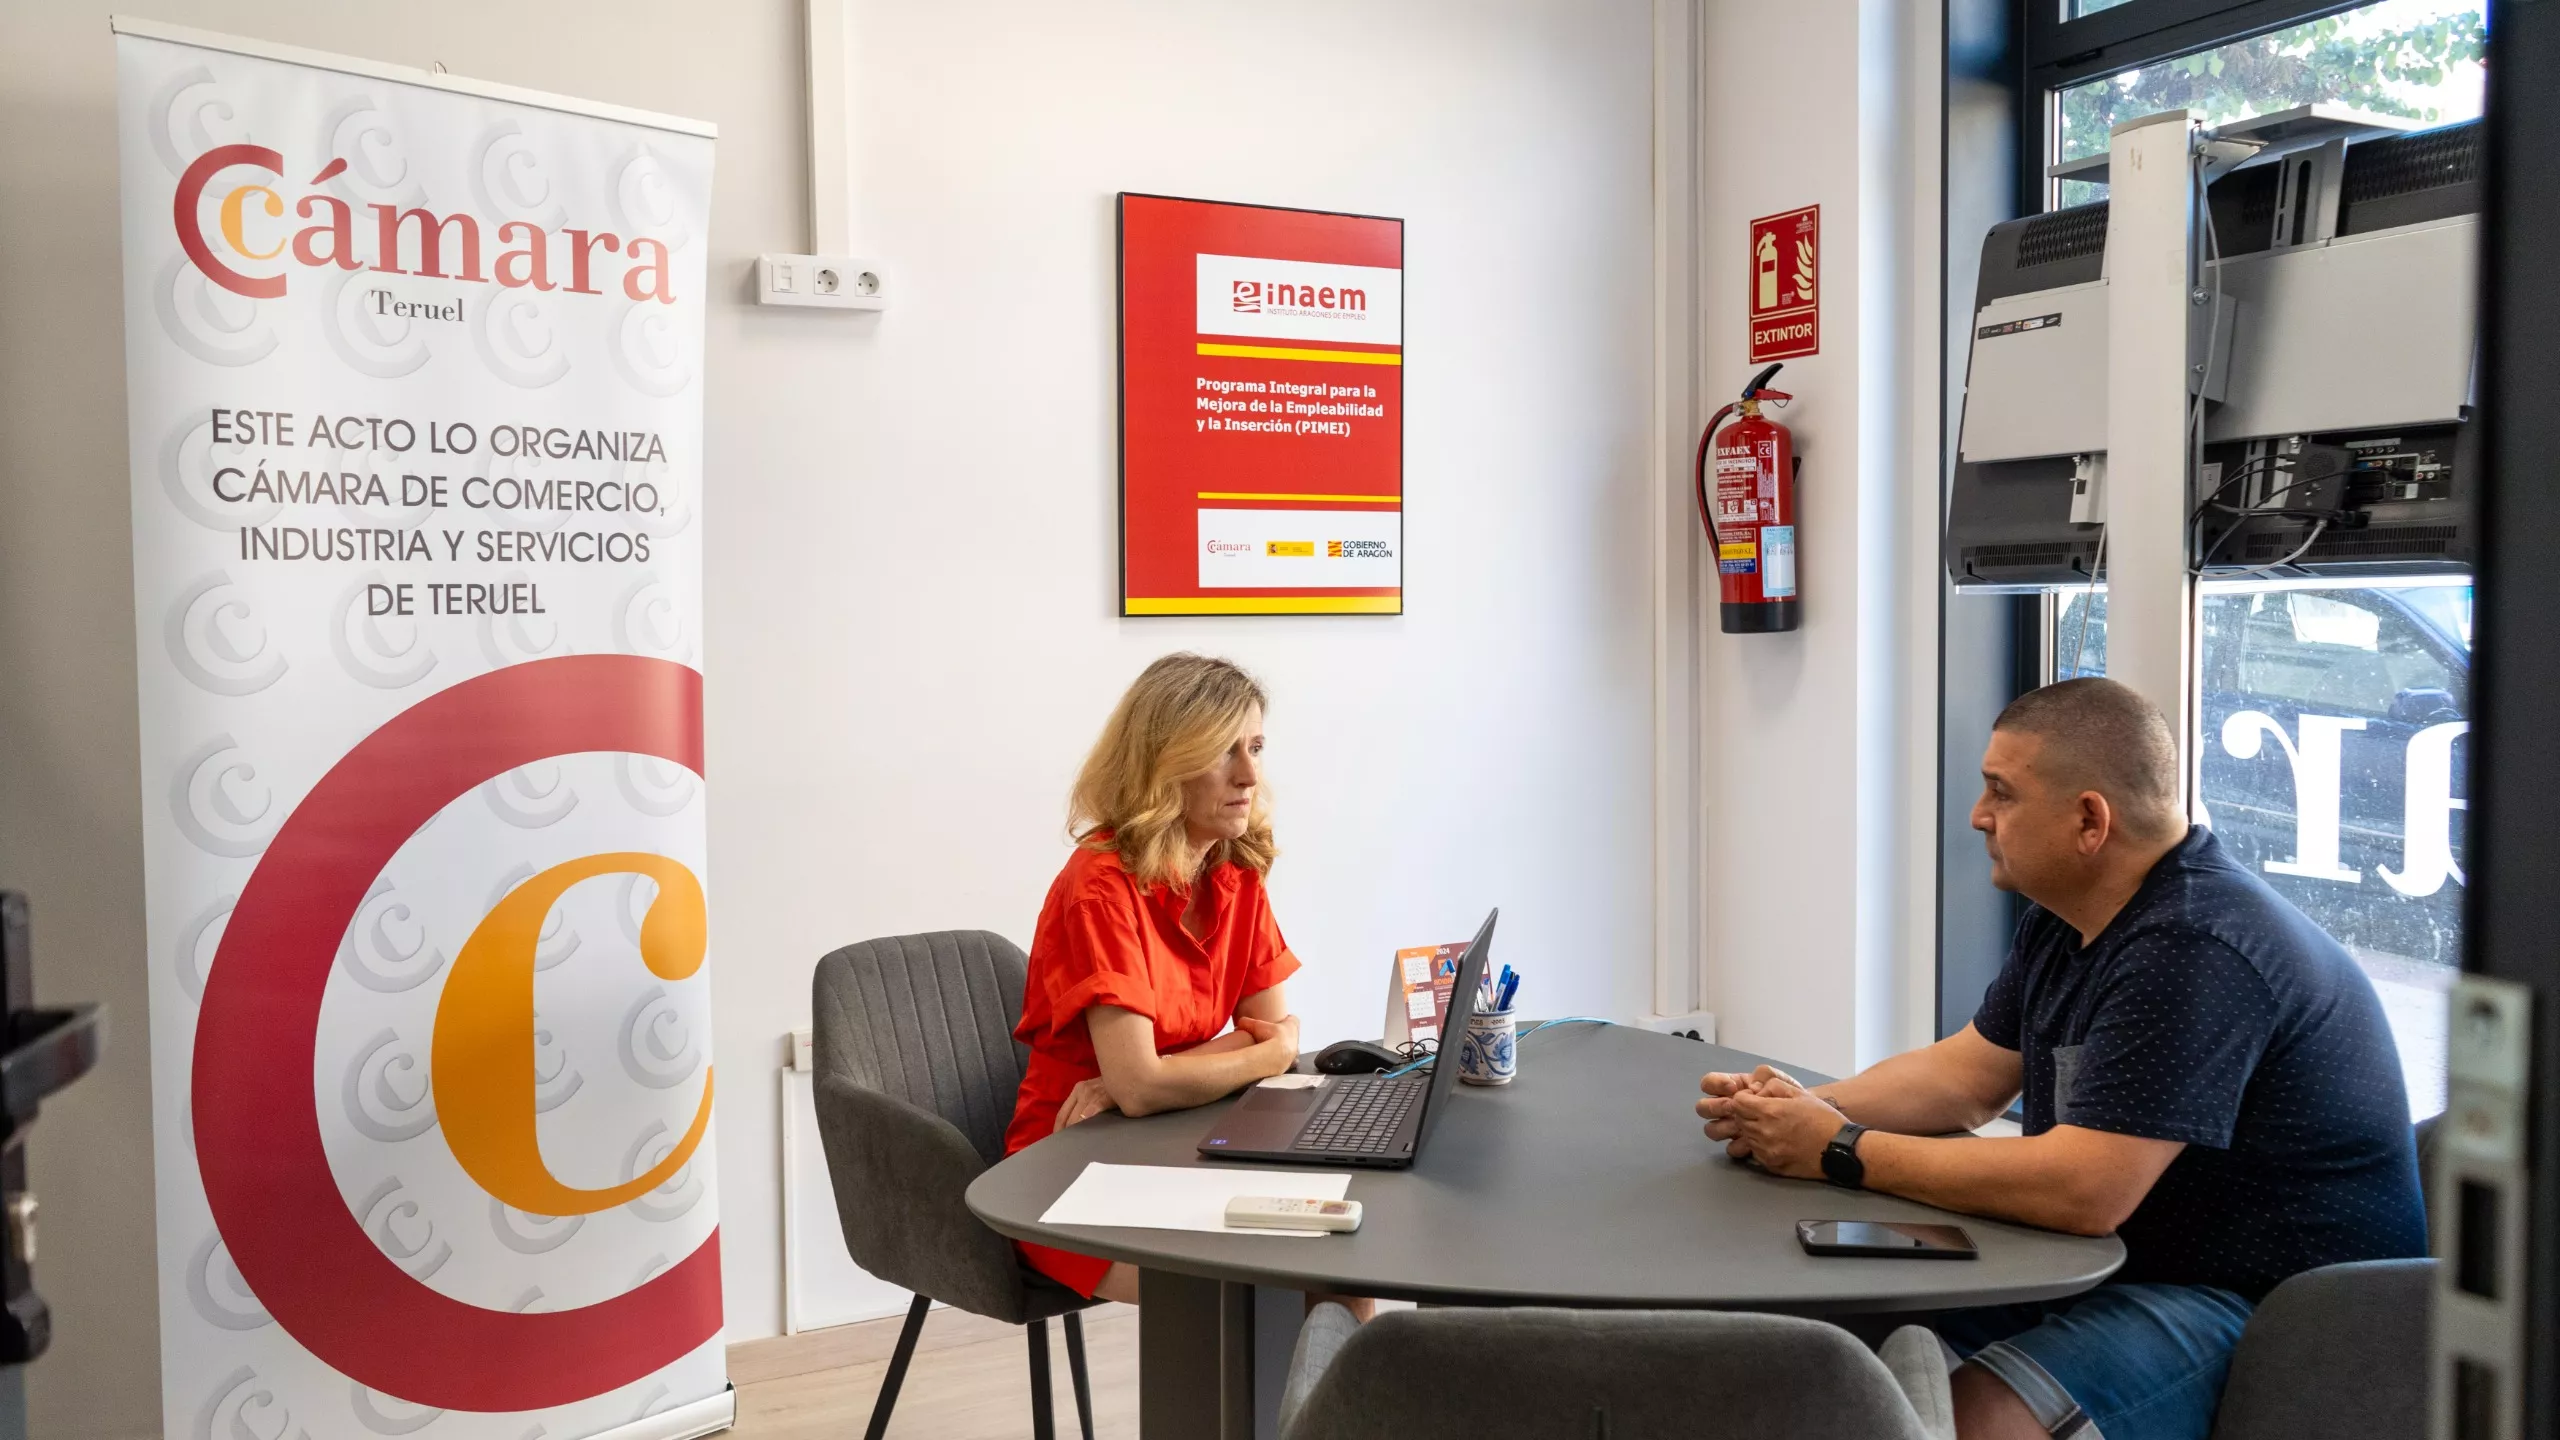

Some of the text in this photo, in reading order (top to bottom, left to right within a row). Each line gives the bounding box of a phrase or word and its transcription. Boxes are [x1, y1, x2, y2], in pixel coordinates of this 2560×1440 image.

[370, 288, 466, 323] Teruel
[1267, 283, 1366, 311] inaem
[1267, 308, 1297, 317] INSTITUTO
[1342, 312, 1366, 320] EMPLEO
[1755, 323, 1812, 345] EXTINTOR
[1196, 377, 1376, 399] Programa Integral para la
[1196, 397, 1384, 417] Mejora de la Empleabilidad
[211, 407, 667, 464] ESTE ACTO LO ORGANIZA
[1196, 417, 1351, 437] y la Inserción (PIMEI)
[212, 459, 666, 517] CÁMARA DE COMERCIO,
[240, 526, 650, 564] INDUSTRIA Y SERVICIOS
[1343, 541, 1387, 549] GOBIERNO
[1343, 549, 1354, 558] DE
[367, 582, 546, 617] DE TERUEL
